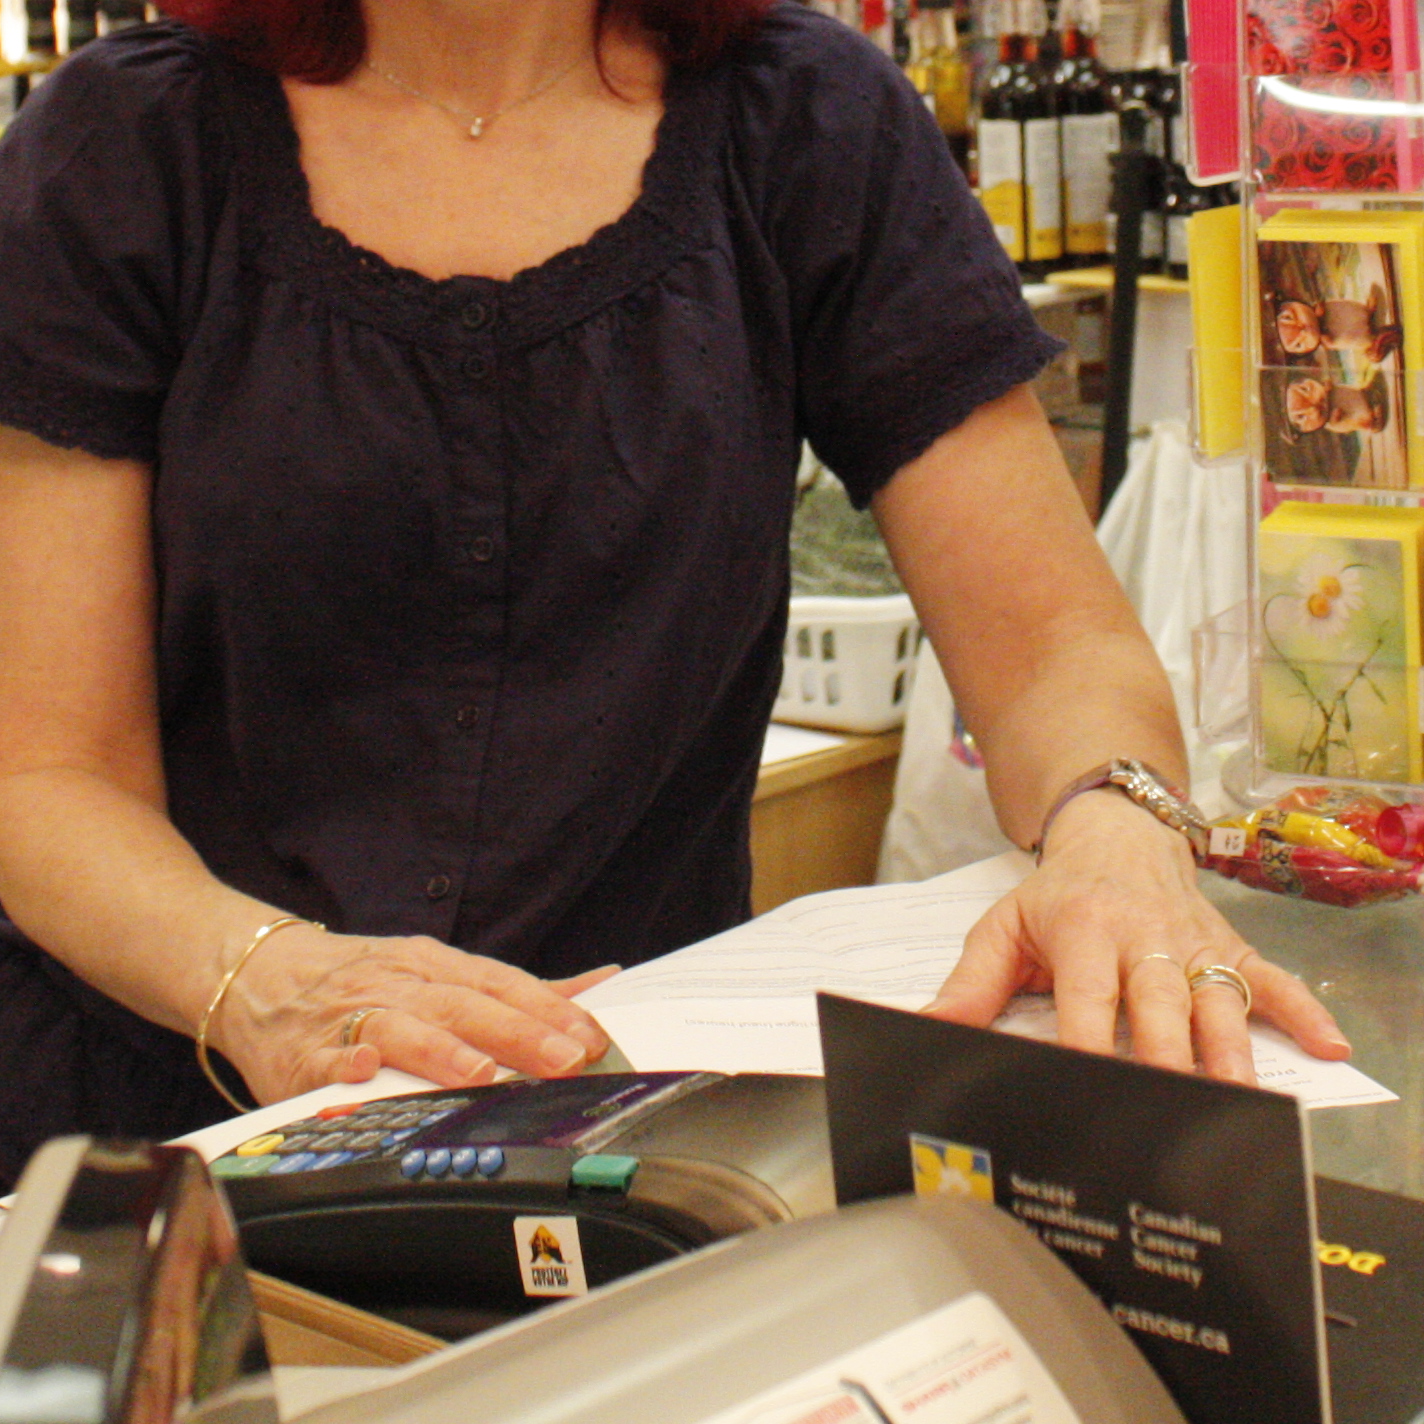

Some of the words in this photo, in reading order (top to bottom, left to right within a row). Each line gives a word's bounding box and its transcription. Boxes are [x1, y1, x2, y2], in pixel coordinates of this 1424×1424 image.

[1128, 1202, 1223, 1246] Canadian
[1130, 1226, 1198, 1261] Cancer
[1132, 1249, 1204, 1289] Society
